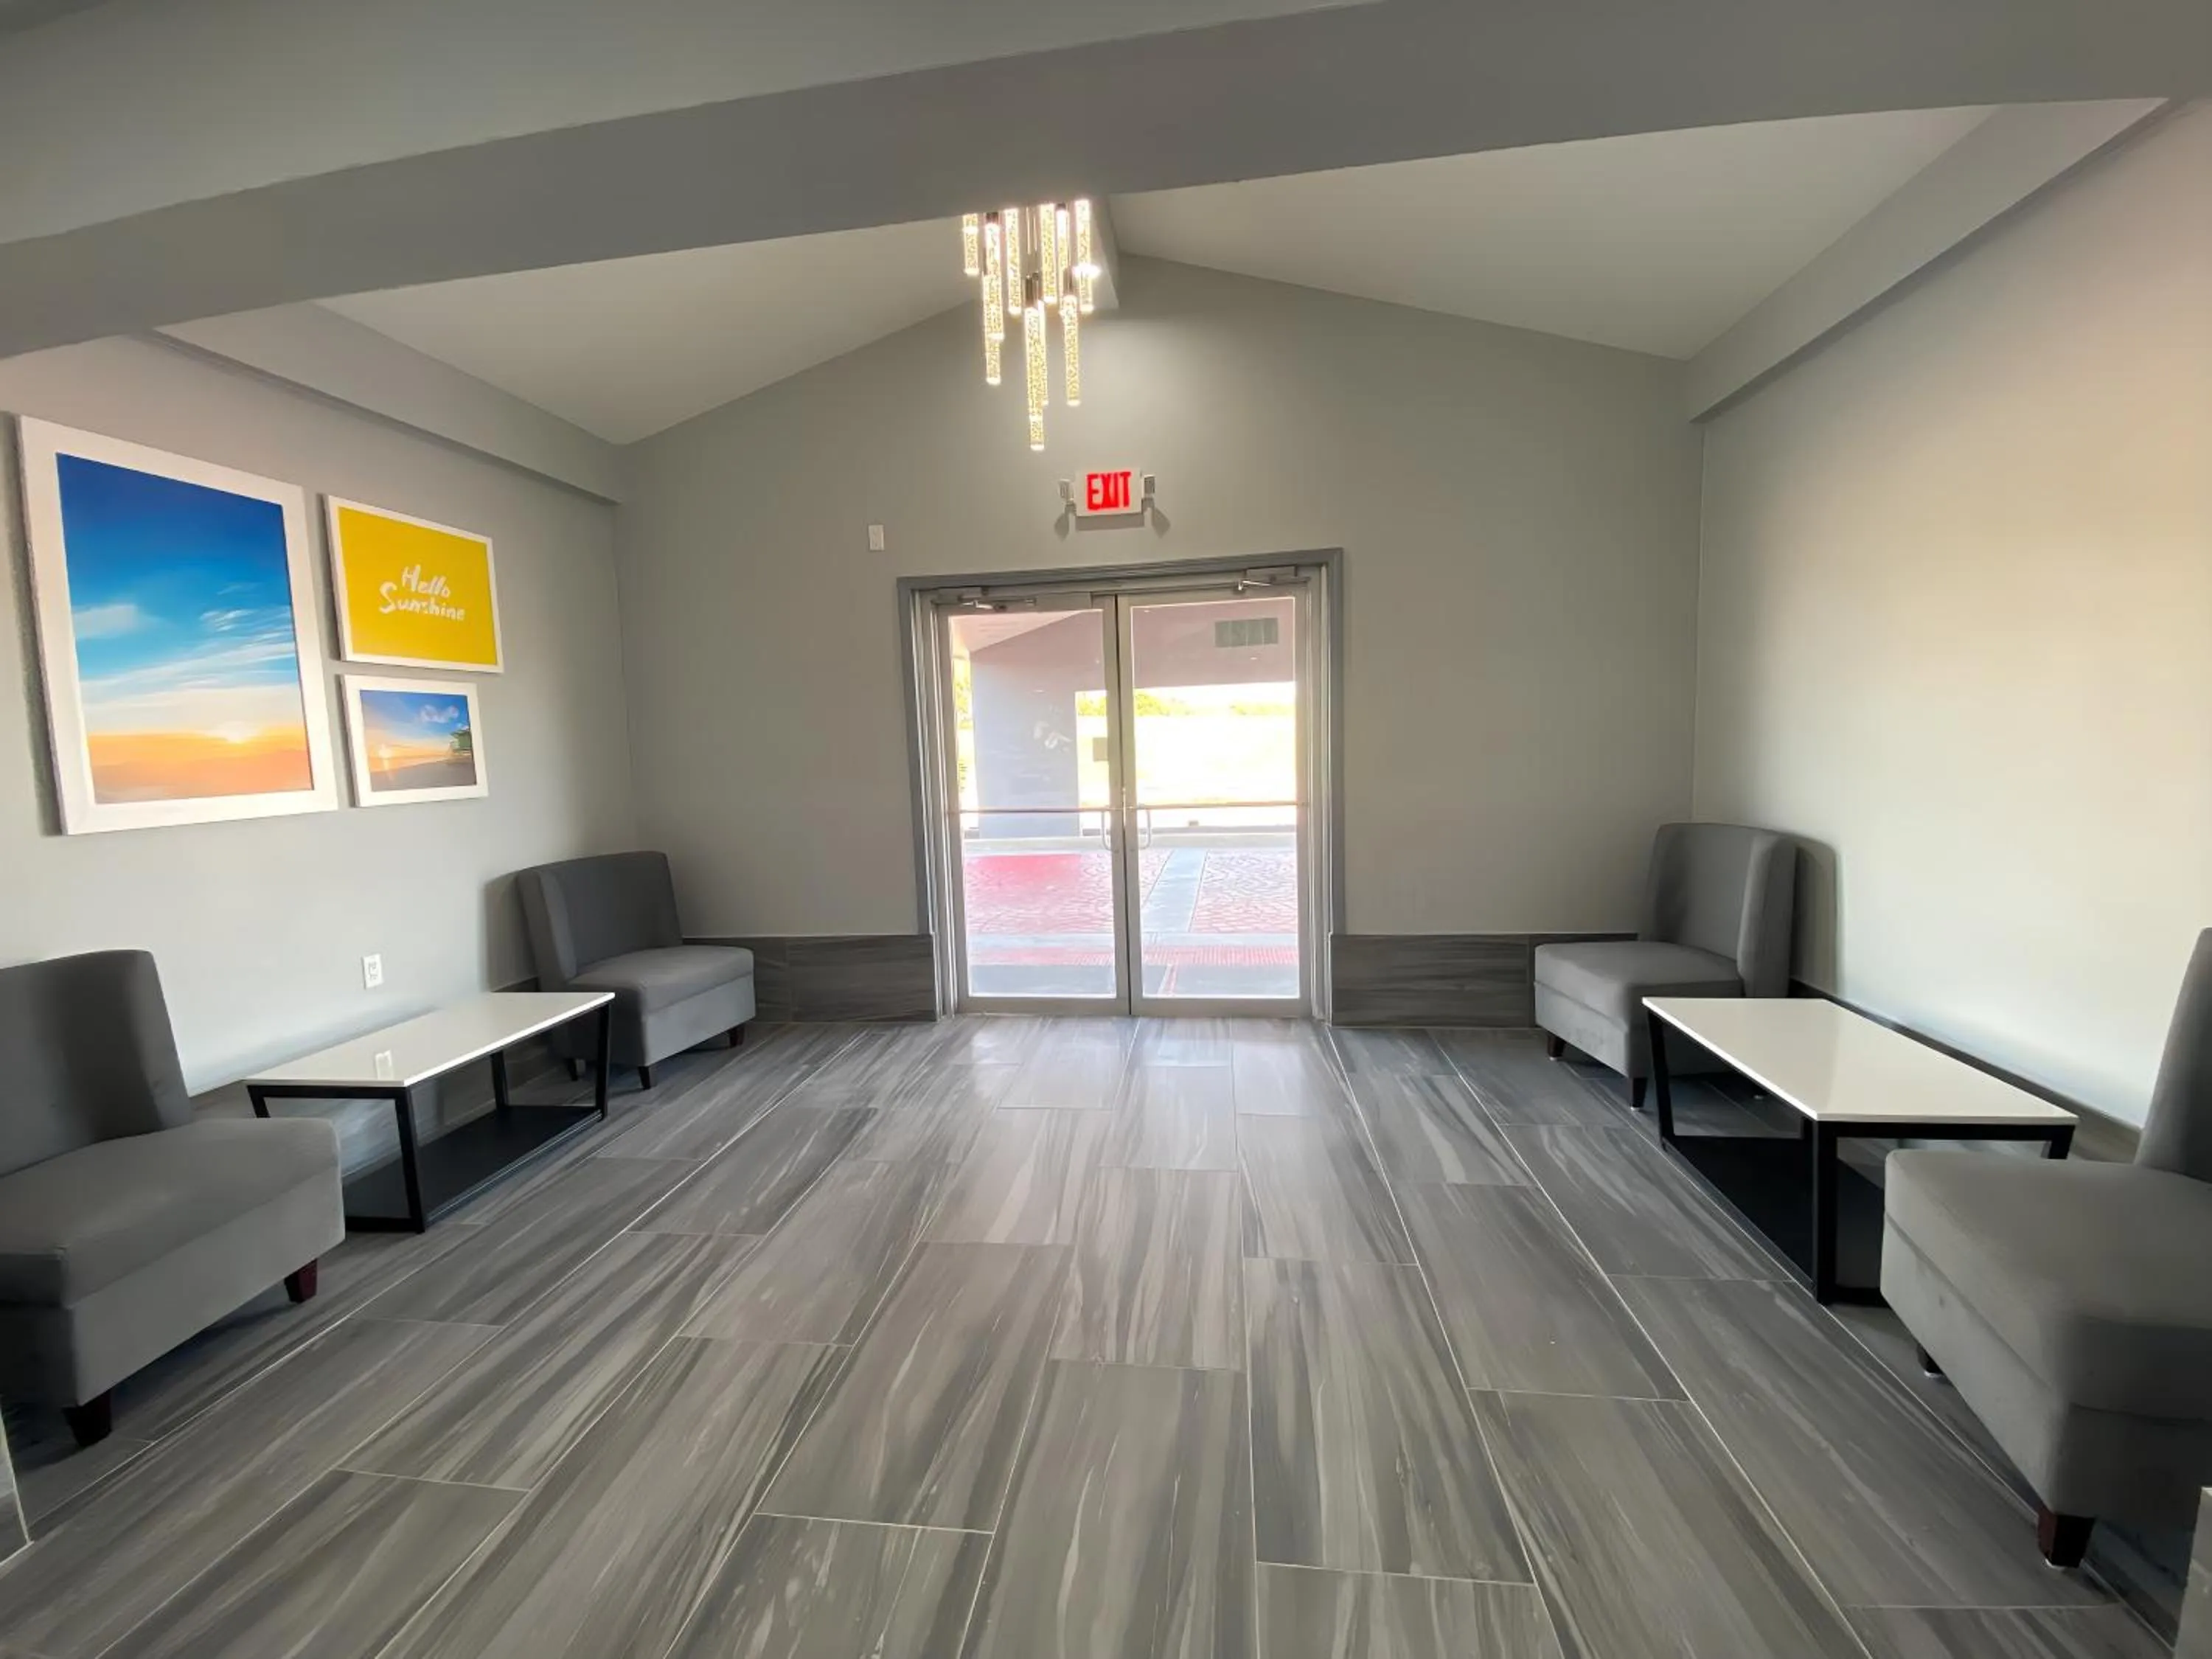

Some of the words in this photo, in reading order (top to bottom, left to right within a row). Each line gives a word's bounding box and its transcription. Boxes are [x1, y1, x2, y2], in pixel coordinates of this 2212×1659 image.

[1087, 471, 1132, 510] EXIT
[401, 564, 451, 598] Hello
[379, 581, 465, 621] Sunshine
